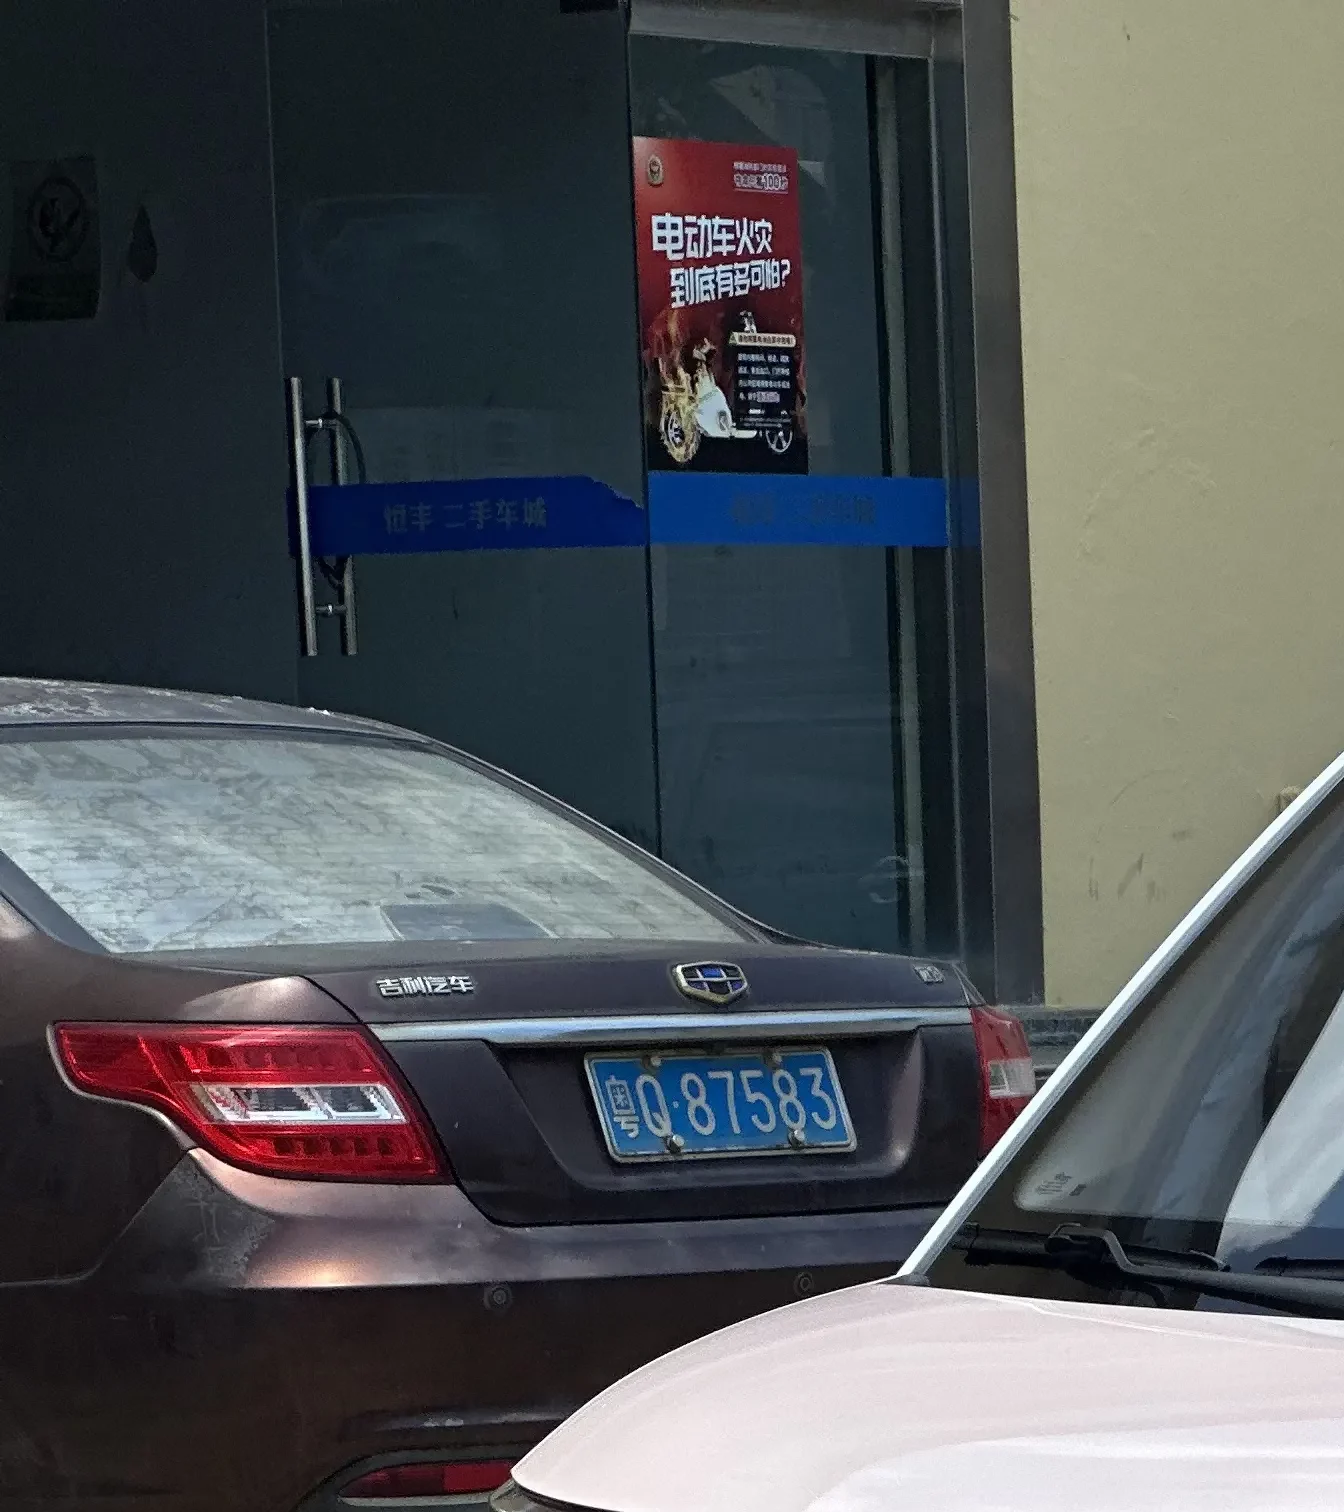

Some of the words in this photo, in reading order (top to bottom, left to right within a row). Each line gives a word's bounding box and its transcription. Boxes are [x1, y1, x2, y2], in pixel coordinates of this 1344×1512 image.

[652, 212, 773, 261] 电动车火灾
[376, 975, 475, 997] 吉利汽车
